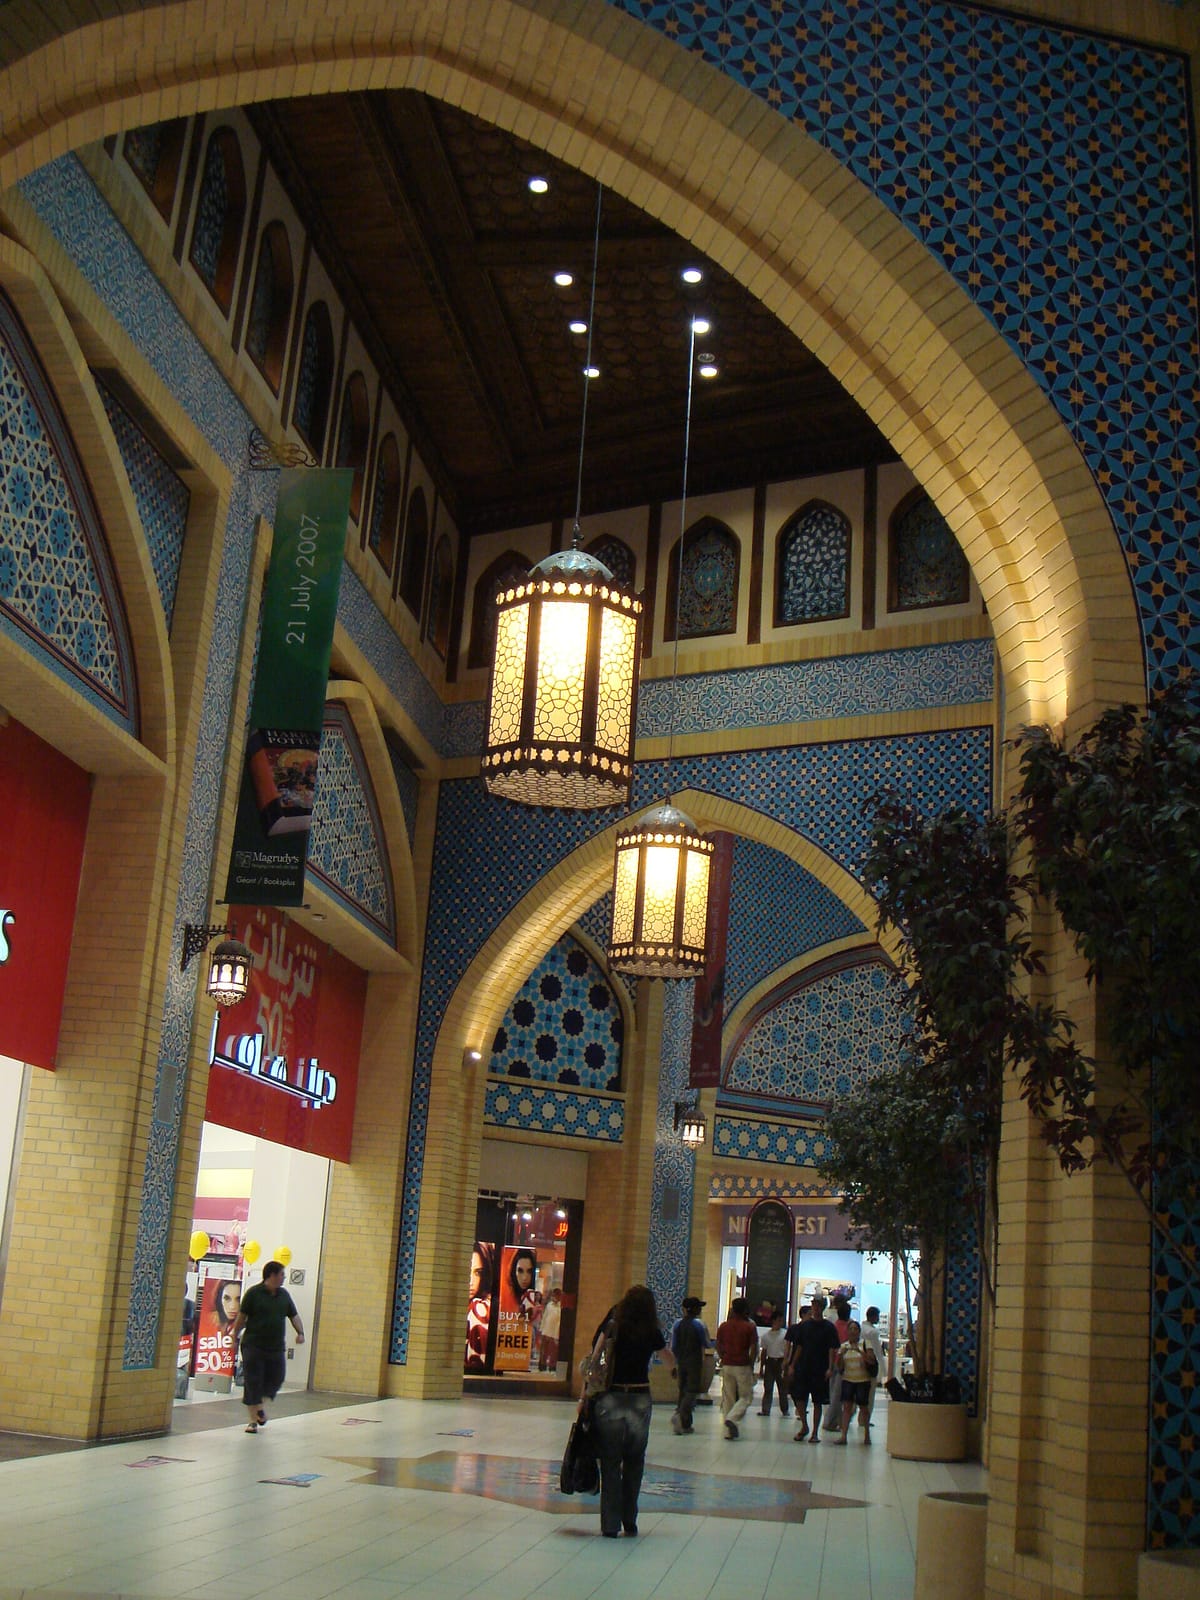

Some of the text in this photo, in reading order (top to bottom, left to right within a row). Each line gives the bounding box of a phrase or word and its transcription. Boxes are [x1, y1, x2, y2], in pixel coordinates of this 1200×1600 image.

[290, 574, 318, 612] July
[286, 622, 306, 644] 21
[252, 852, 300, 864] Magrudy's
[795, 1215, 828, 1235] EST
[499, 1311, 530, 1322] BUY 1
[498, 1323, 529, 1333] GET 1
[199, 1332, 232, 1350] sale
[497, 1334, 529, 1349] FREE
[221, 1361, 234, 1370] OFF
